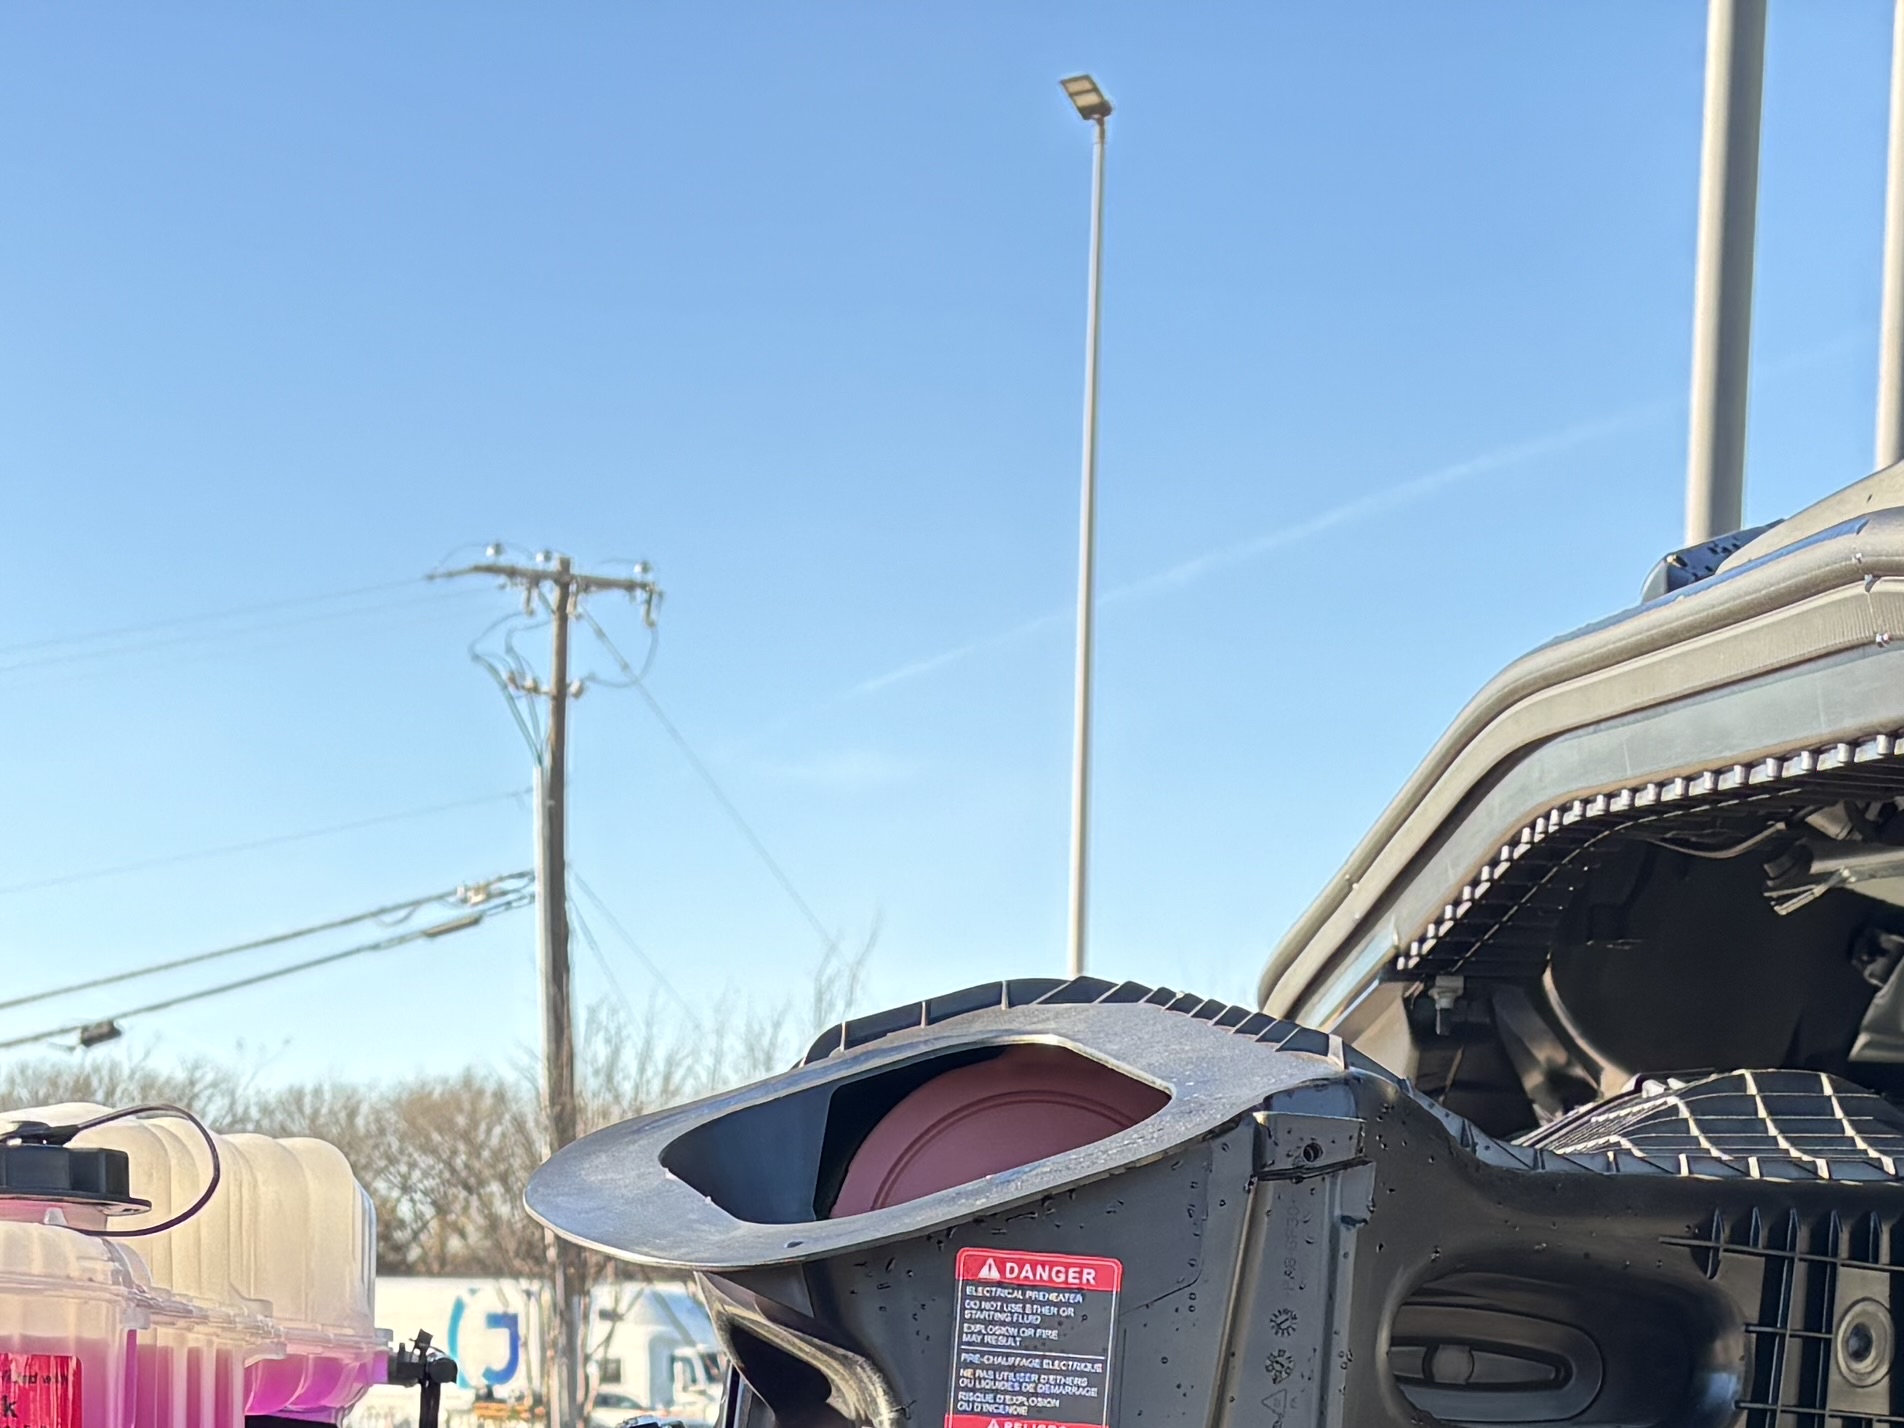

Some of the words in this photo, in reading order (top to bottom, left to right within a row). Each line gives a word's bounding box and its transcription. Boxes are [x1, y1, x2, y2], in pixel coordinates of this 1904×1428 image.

[1006, 1262, 1096, 1285] DANGER
[965, 1285, 1023, 1300] ELECTRICAL
[964, 1309, 1012, 1323] STARTING
[1012, 1311, 1042, 1325] FLUID
[981, 1300, 1001, 1312] NOT
[1003, 1302, 1023, 1314] USE
[1059, 1306, 1075, 1318] OR
[962, 1333, 982, 1344] MAY
[983, 1335, 1023, 1347] RESULT
[963, 1322, 1018, 1337] EXPLOSION
[1036, 1328, 1059, 1341] FIRE
